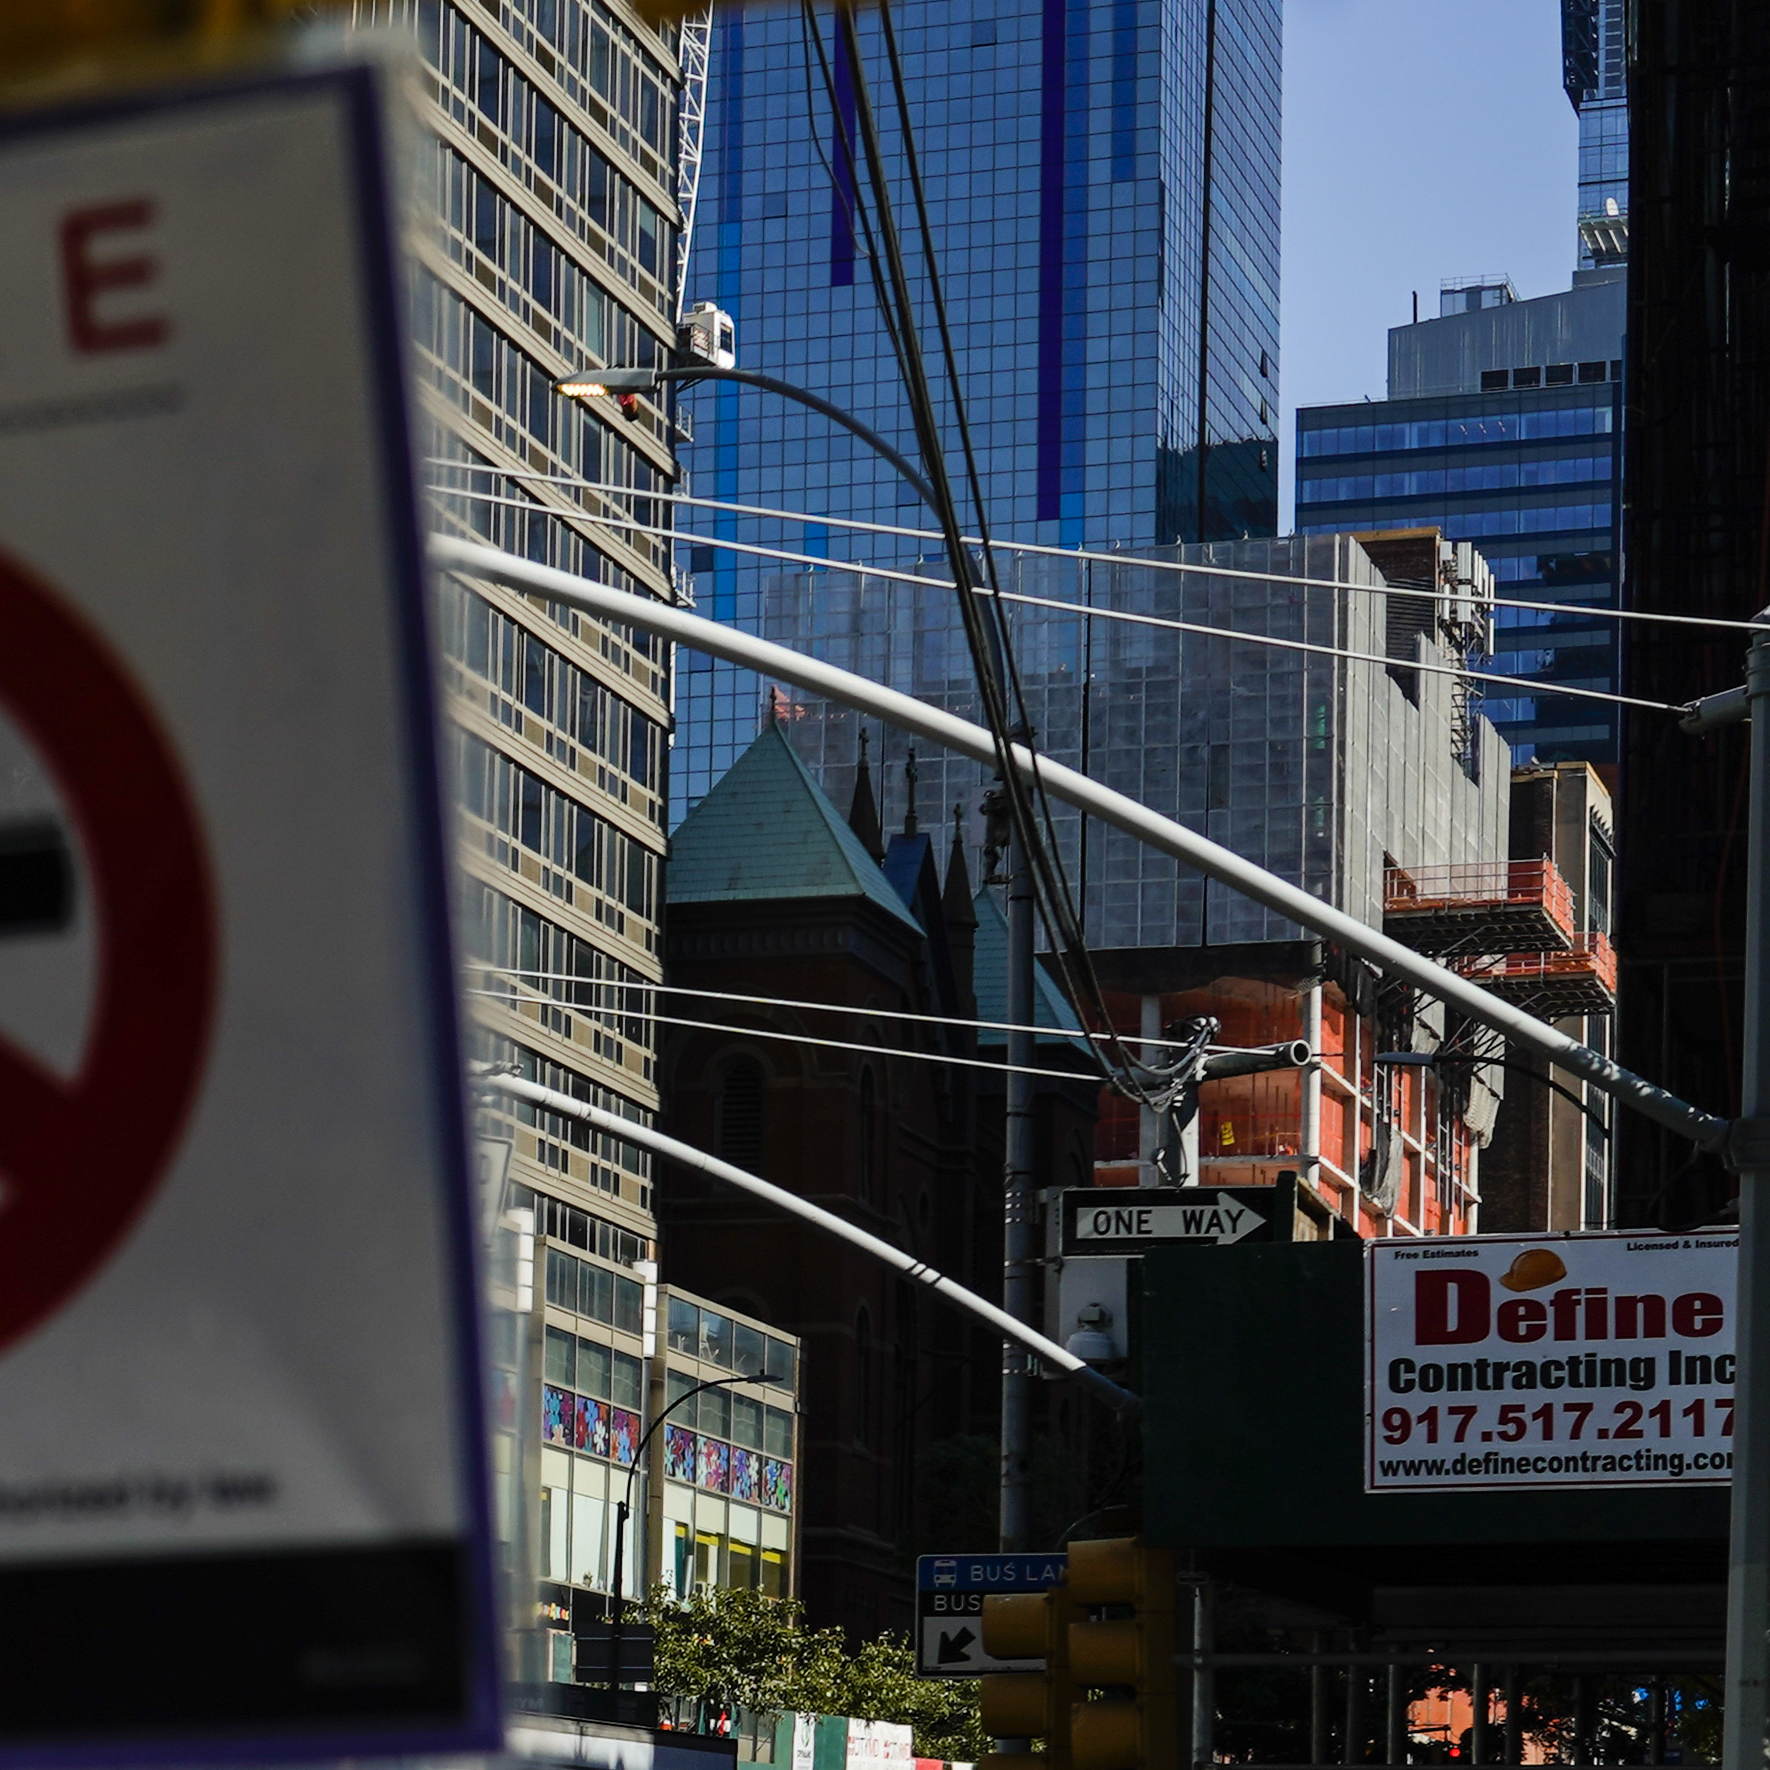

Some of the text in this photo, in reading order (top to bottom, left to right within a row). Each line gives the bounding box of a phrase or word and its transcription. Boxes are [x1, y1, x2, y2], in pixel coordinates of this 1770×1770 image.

[1093, 1208, 1245, 1236] ONE WAY
[1394, 1248, 1479, 1260] Free Estimates
[1627, 1238, 1739, 1251] Licensed & Insured
[1415, 1269, 1724, 1346] Define
[1388, 1352, 1656, 1394] Contracting
[1381, 1398, 1734, 1445] 917.517.2117
[970, 1563, 1016, 1582] BUS
